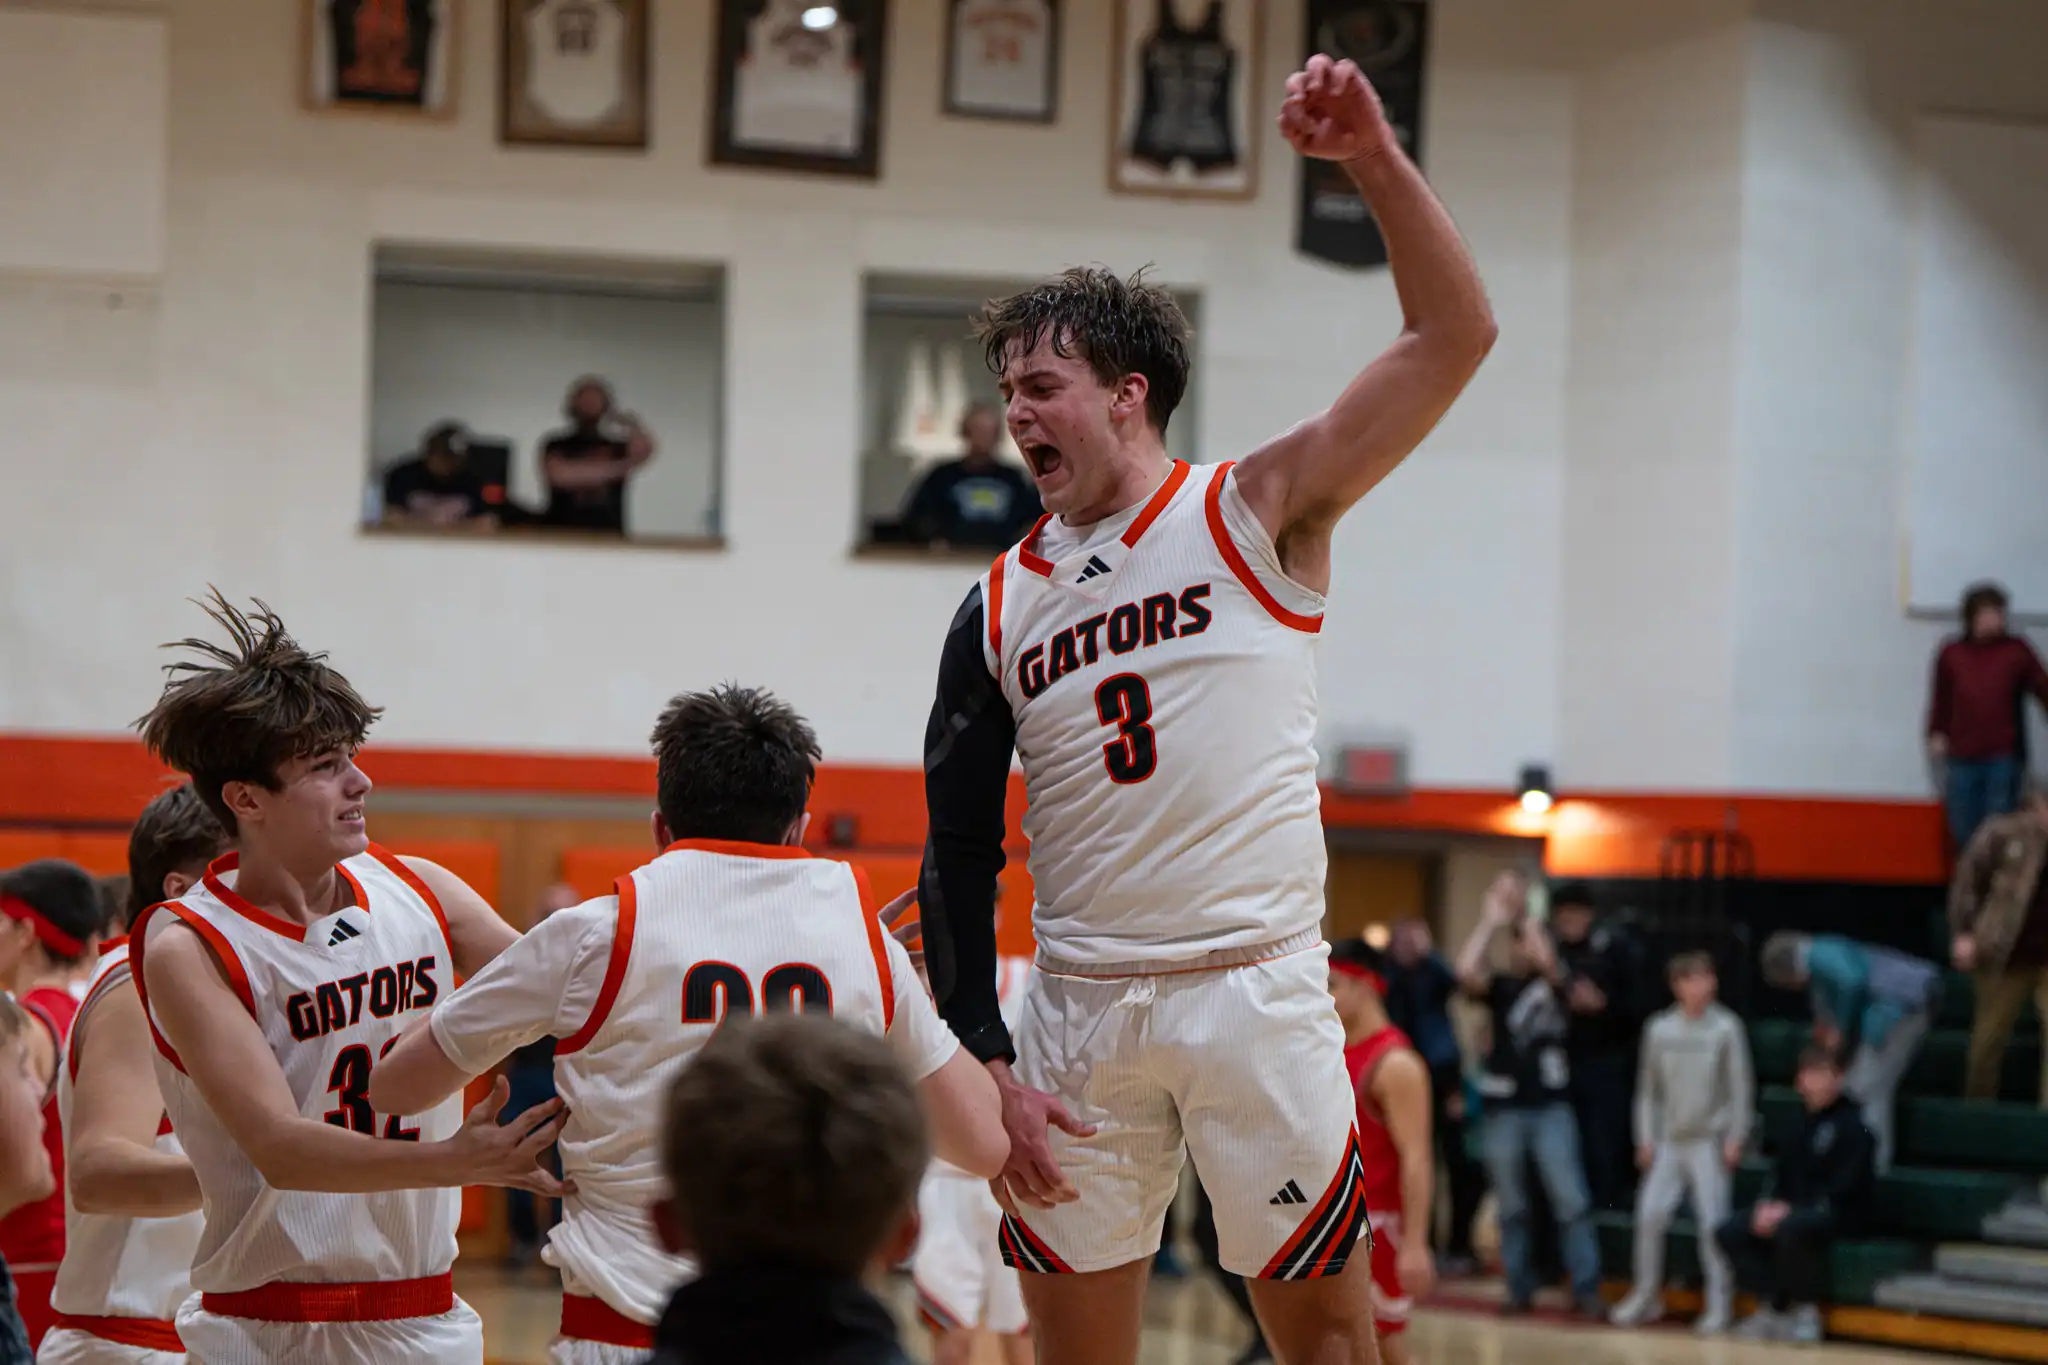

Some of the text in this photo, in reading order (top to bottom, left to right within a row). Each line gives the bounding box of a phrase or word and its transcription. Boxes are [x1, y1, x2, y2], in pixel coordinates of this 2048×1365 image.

[1017, 583, 1212, 700] GATORS
[1095, 672, 1158, 784] 3
[286, 956, 438, 1043] GATORS
